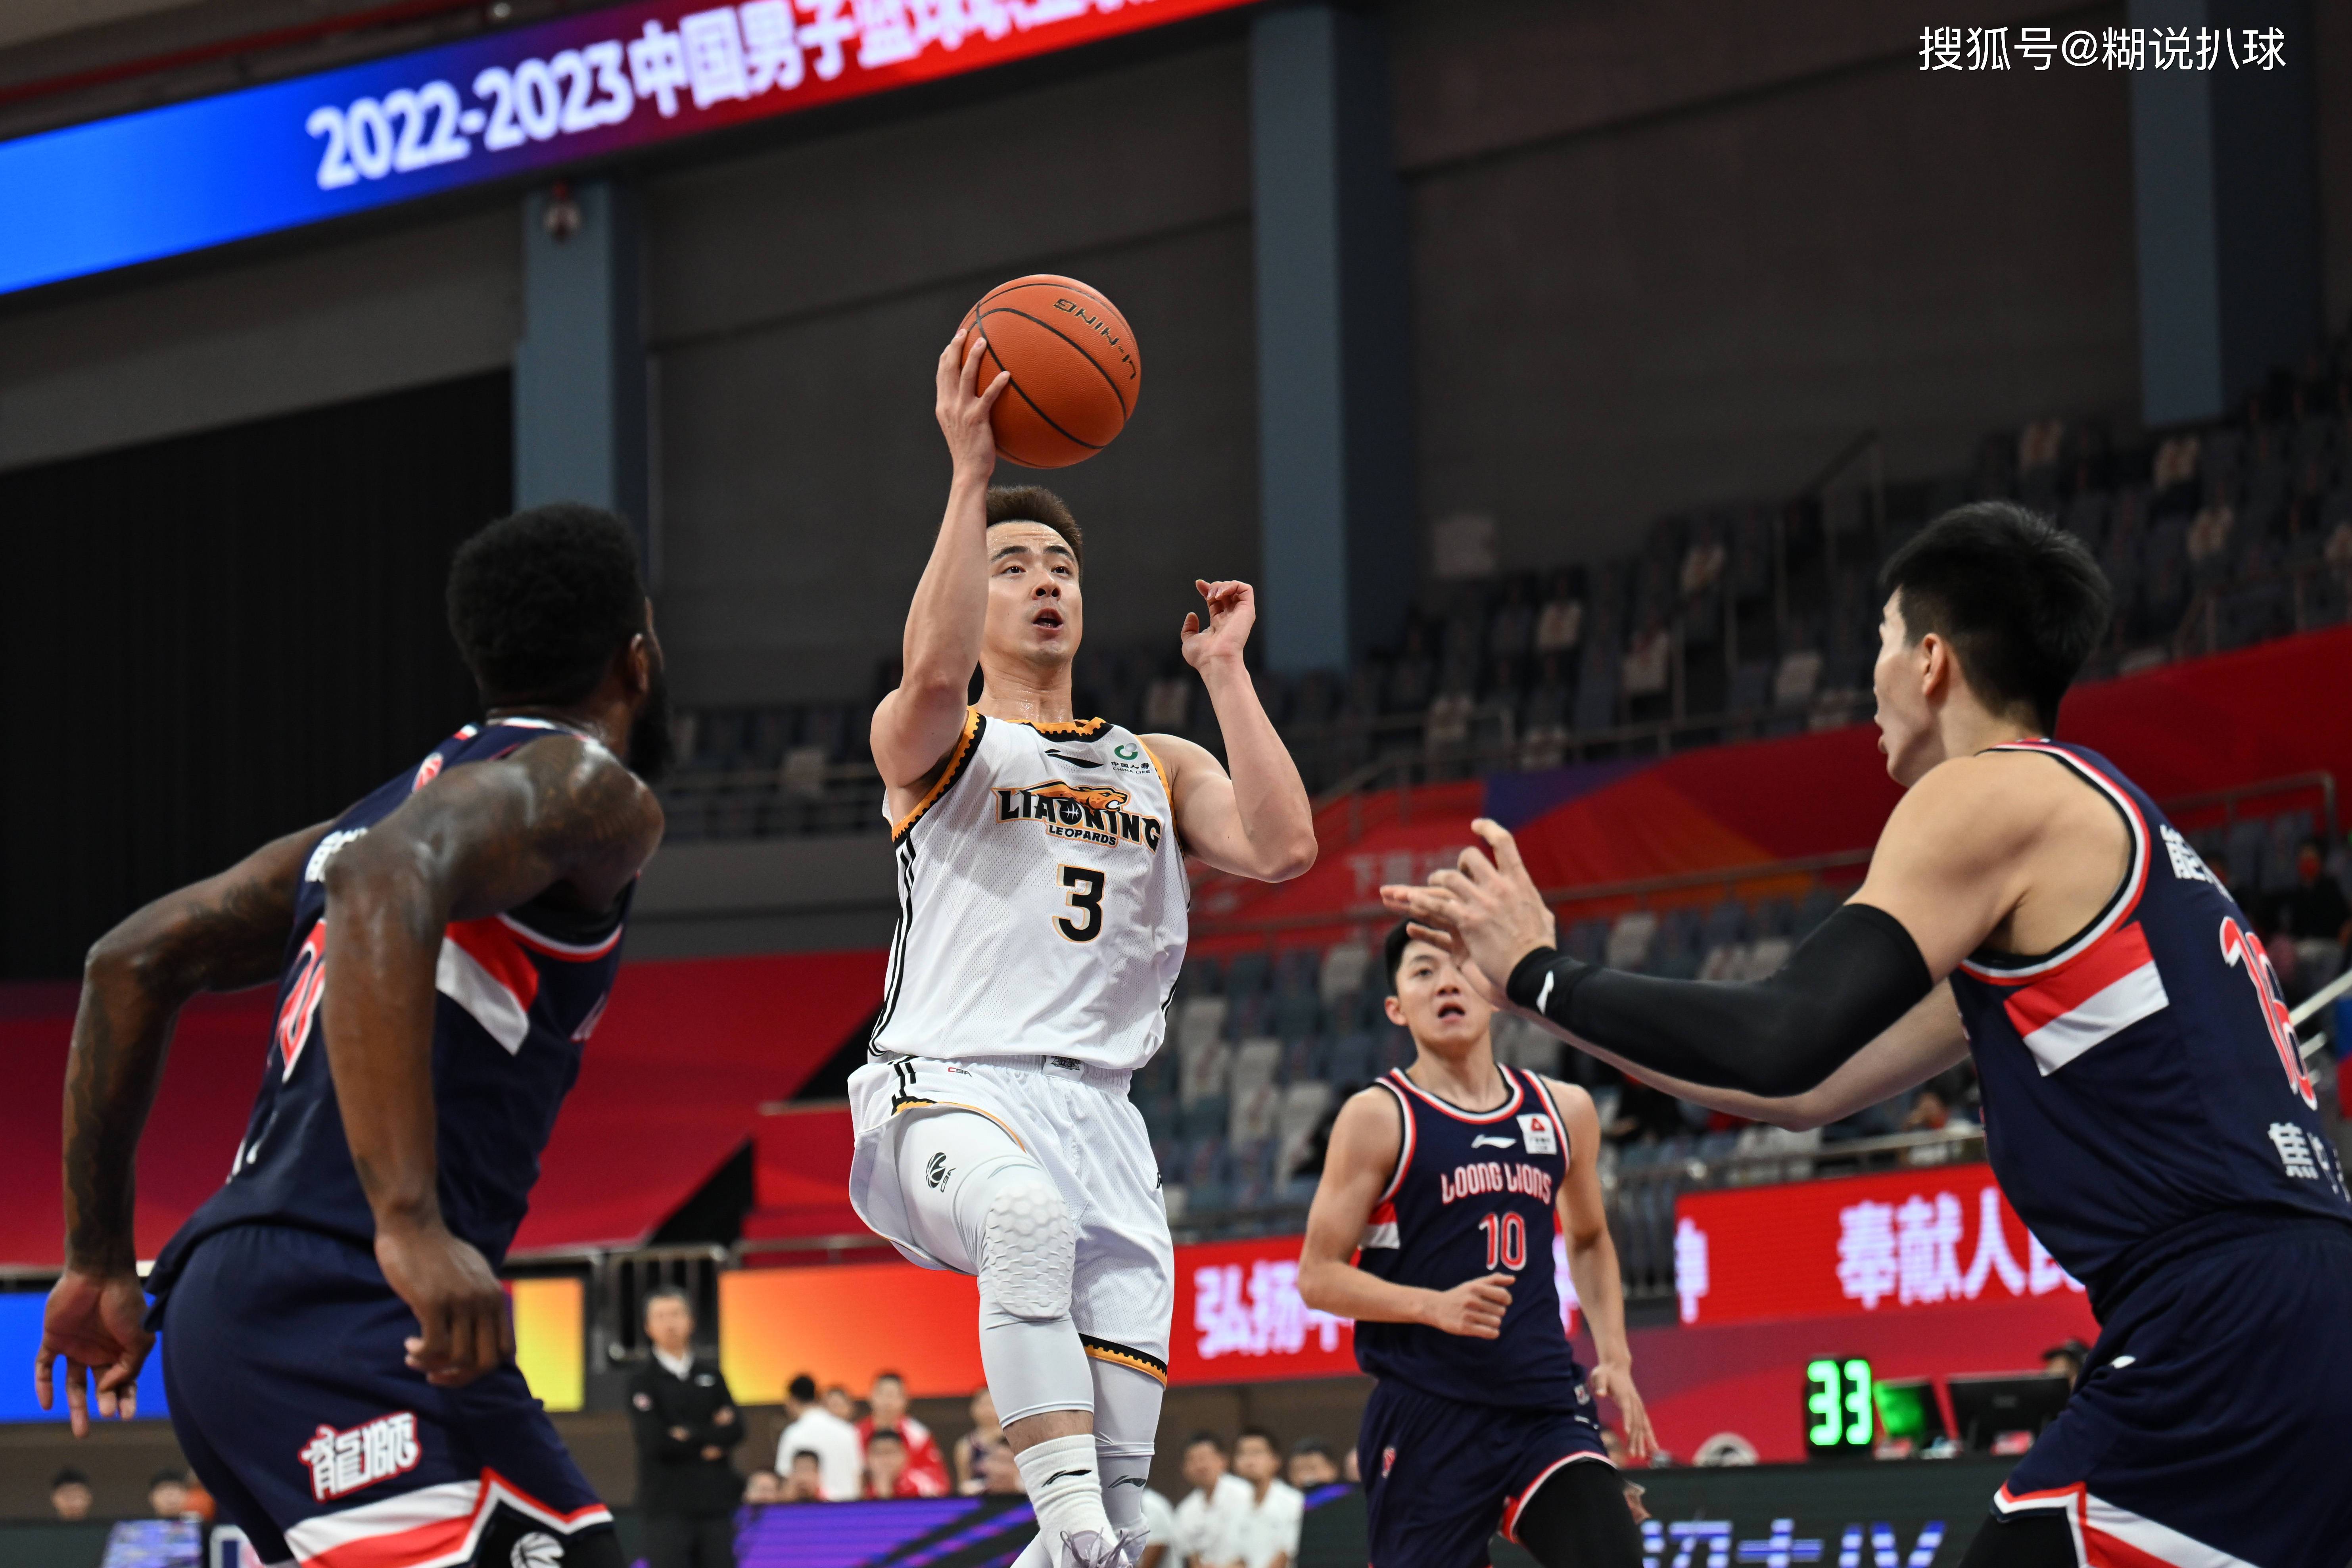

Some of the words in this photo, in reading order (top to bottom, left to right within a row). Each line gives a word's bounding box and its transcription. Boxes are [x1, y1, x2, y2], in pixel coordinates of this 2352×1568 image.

[995, 789, 1163, 854] LIAONING
[1048, 825, 1117, 846] LEOPARDS
[1053, 865, 1105, 942] 3
[948, 1067, 972, 1077] CBA
[940, 1167, 956, 1193] CBA
[1479, 1211, 1527, 1271] 10
[1807, 1359, 1872, 1445] 33
